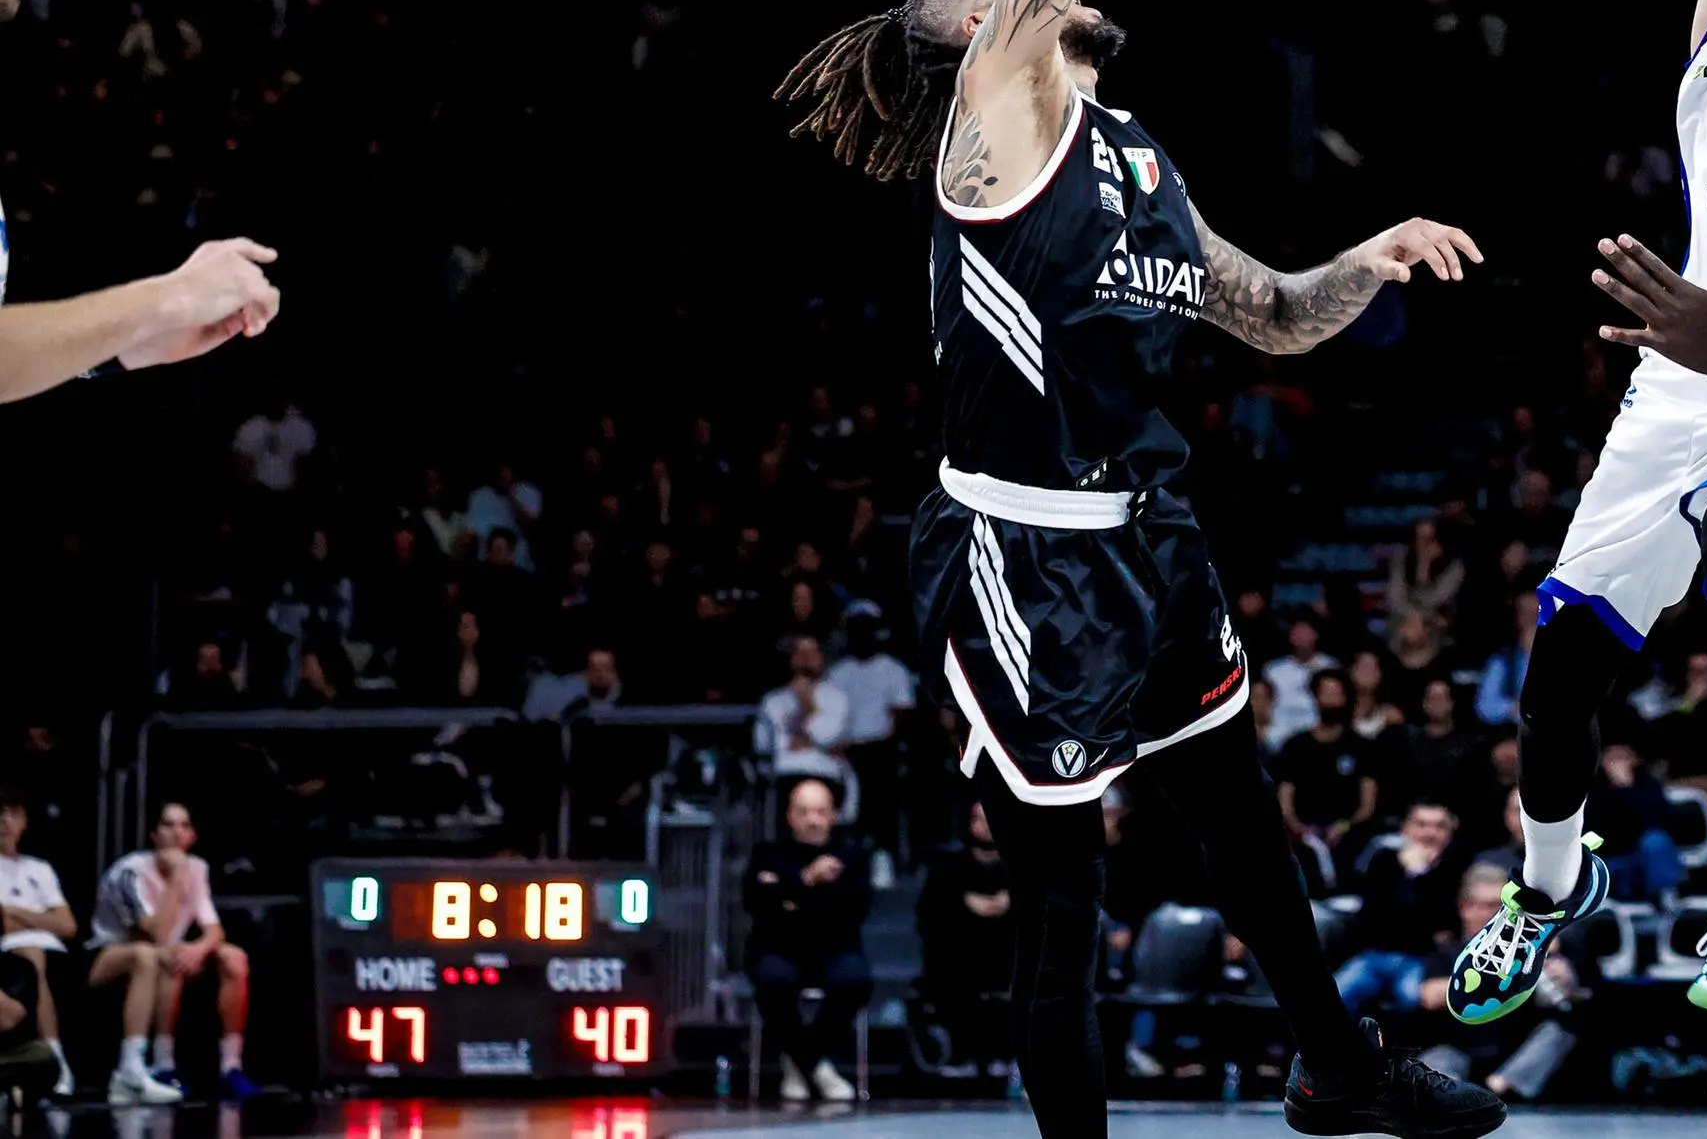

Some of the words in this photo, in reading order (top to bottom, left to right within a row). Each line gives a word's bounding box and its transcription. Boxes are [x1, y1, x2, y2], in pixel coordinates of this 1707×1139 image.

[1095, 289, 1118, 299] THE
[351, 877, 379, 921] 0
[432, 881, 583, 940] 8:18
[621, 879, 649, 923] 0
[355, 957, 437, 991] HOME
[546, 957, 625, 992] GUEST
[347, 1007, 425, 1062] 47
[573, 1007, 650, 1062] 40
